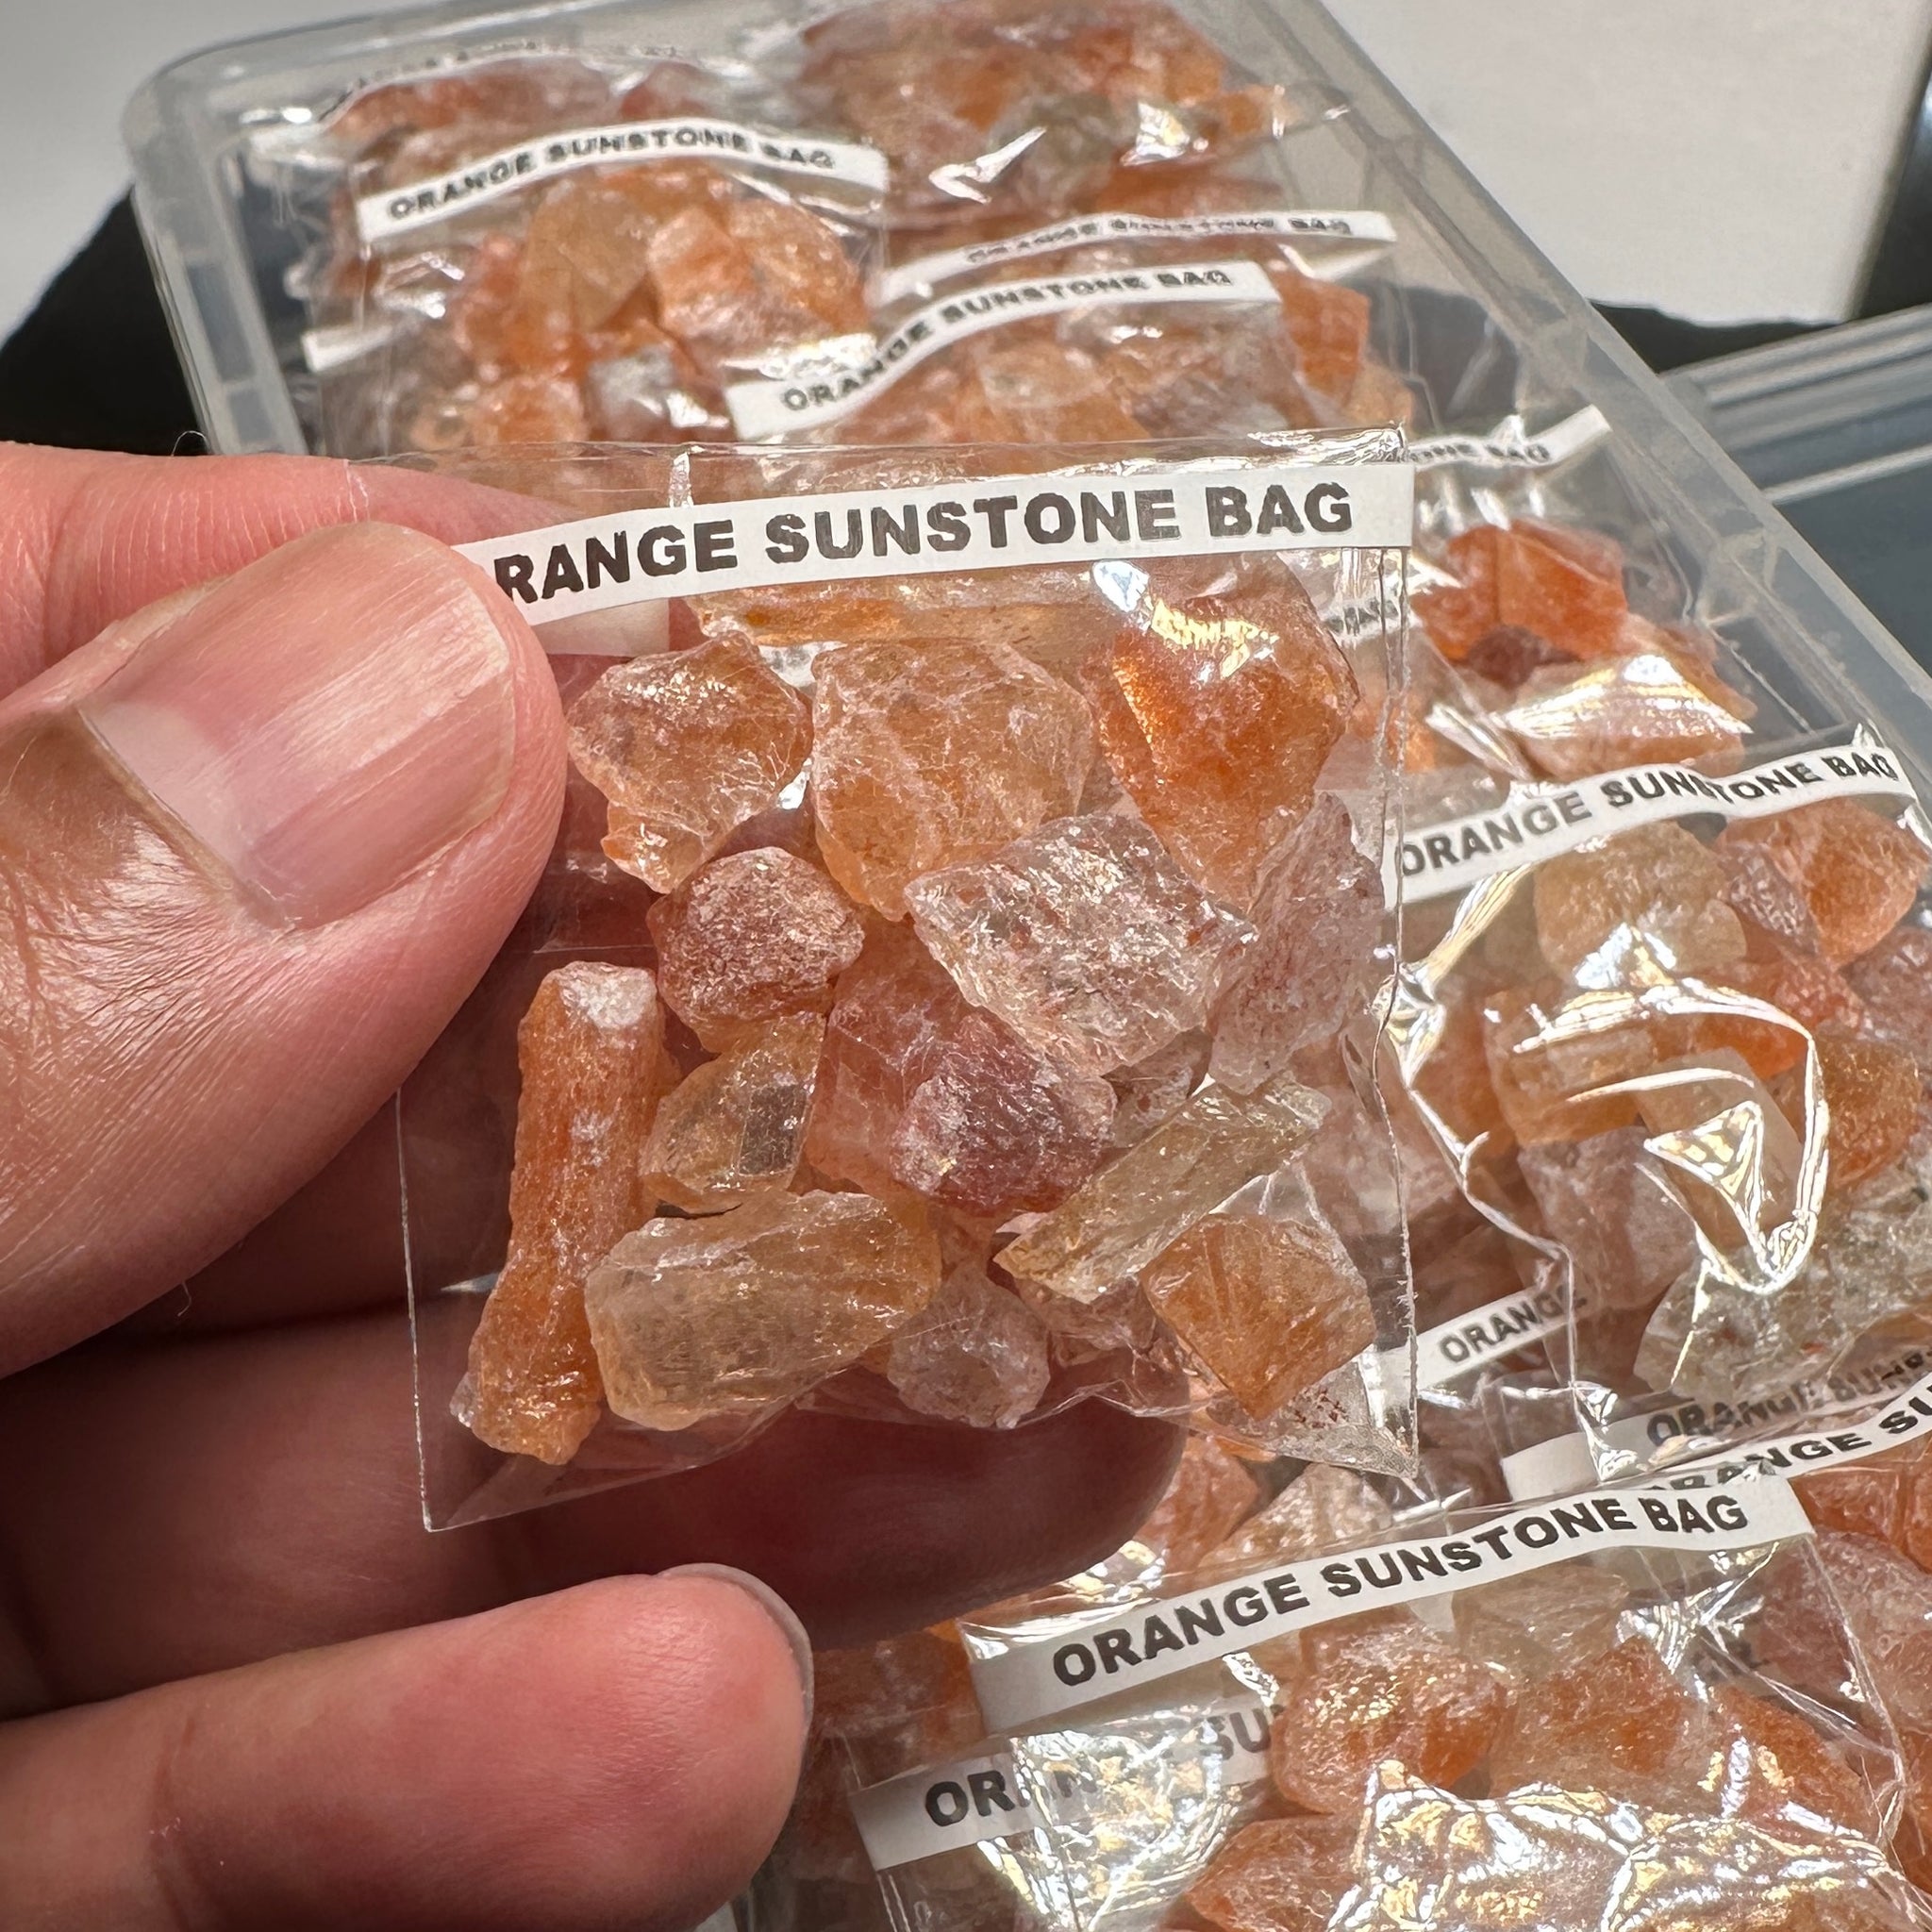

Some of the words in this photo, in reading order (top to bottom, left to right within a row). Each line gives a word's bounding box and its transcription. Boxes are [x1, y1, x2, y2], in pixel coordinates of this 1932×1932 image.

[494, 519, 738, 604] RANGE
[765, 489, 1181, 565] SUNSTONE
[1206, 482, 1352, 538] BAG
[1396, 791, 1592, 876] ORANGE
[1053, 1573, 1310, 1686] ORANGE
[1321, 1499, 1637, 1597] SUNSTONE
[1640, 1495, 1748, 1532] BAG
